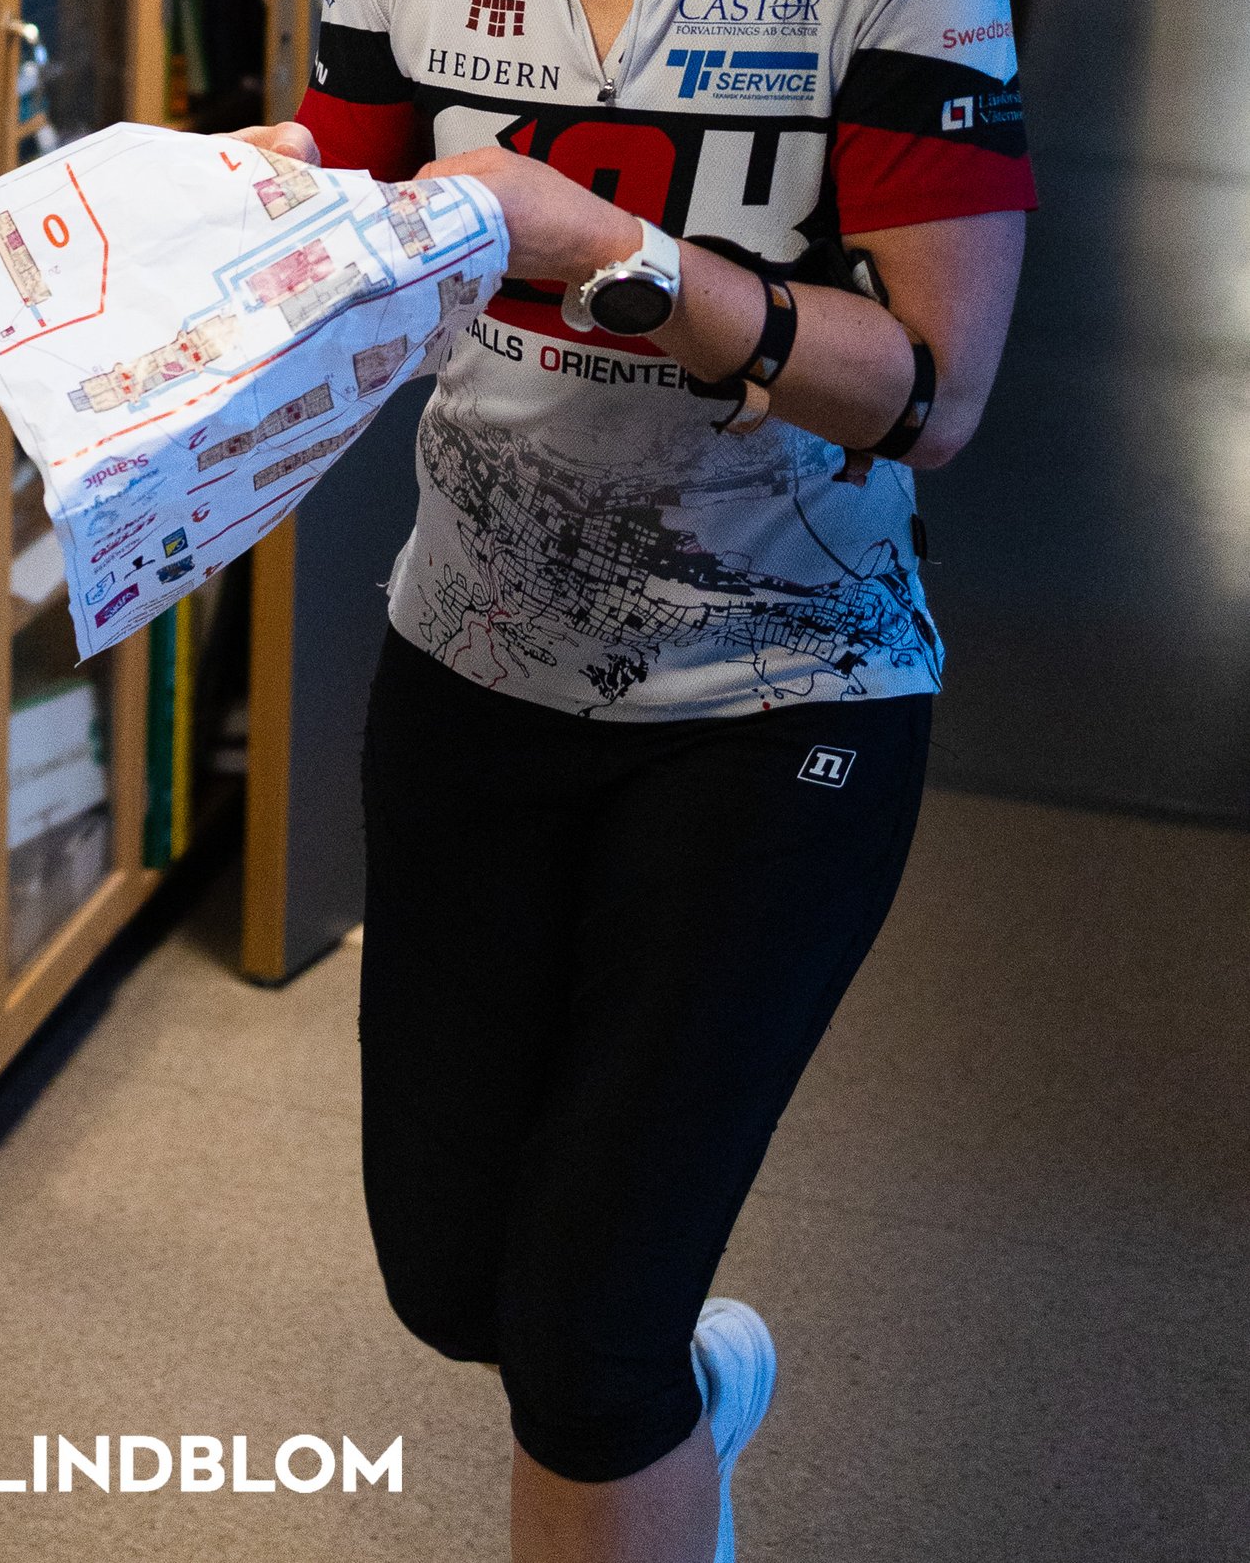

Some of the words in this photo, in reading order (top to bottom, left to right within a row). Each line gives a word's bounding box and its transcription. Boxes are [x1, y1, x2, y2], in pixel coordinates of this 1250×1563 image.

[427, 48, 560, 90] HEDERN
[716, 72, 817, 93] SERVICE
[43, 214, 69, 248] 0
[466, 318, 523, 362] ALLS
[189, 426, 208, 450] 2
[83, 453, 149, 489] Scandic
[191, 501, 211, 523] 3
